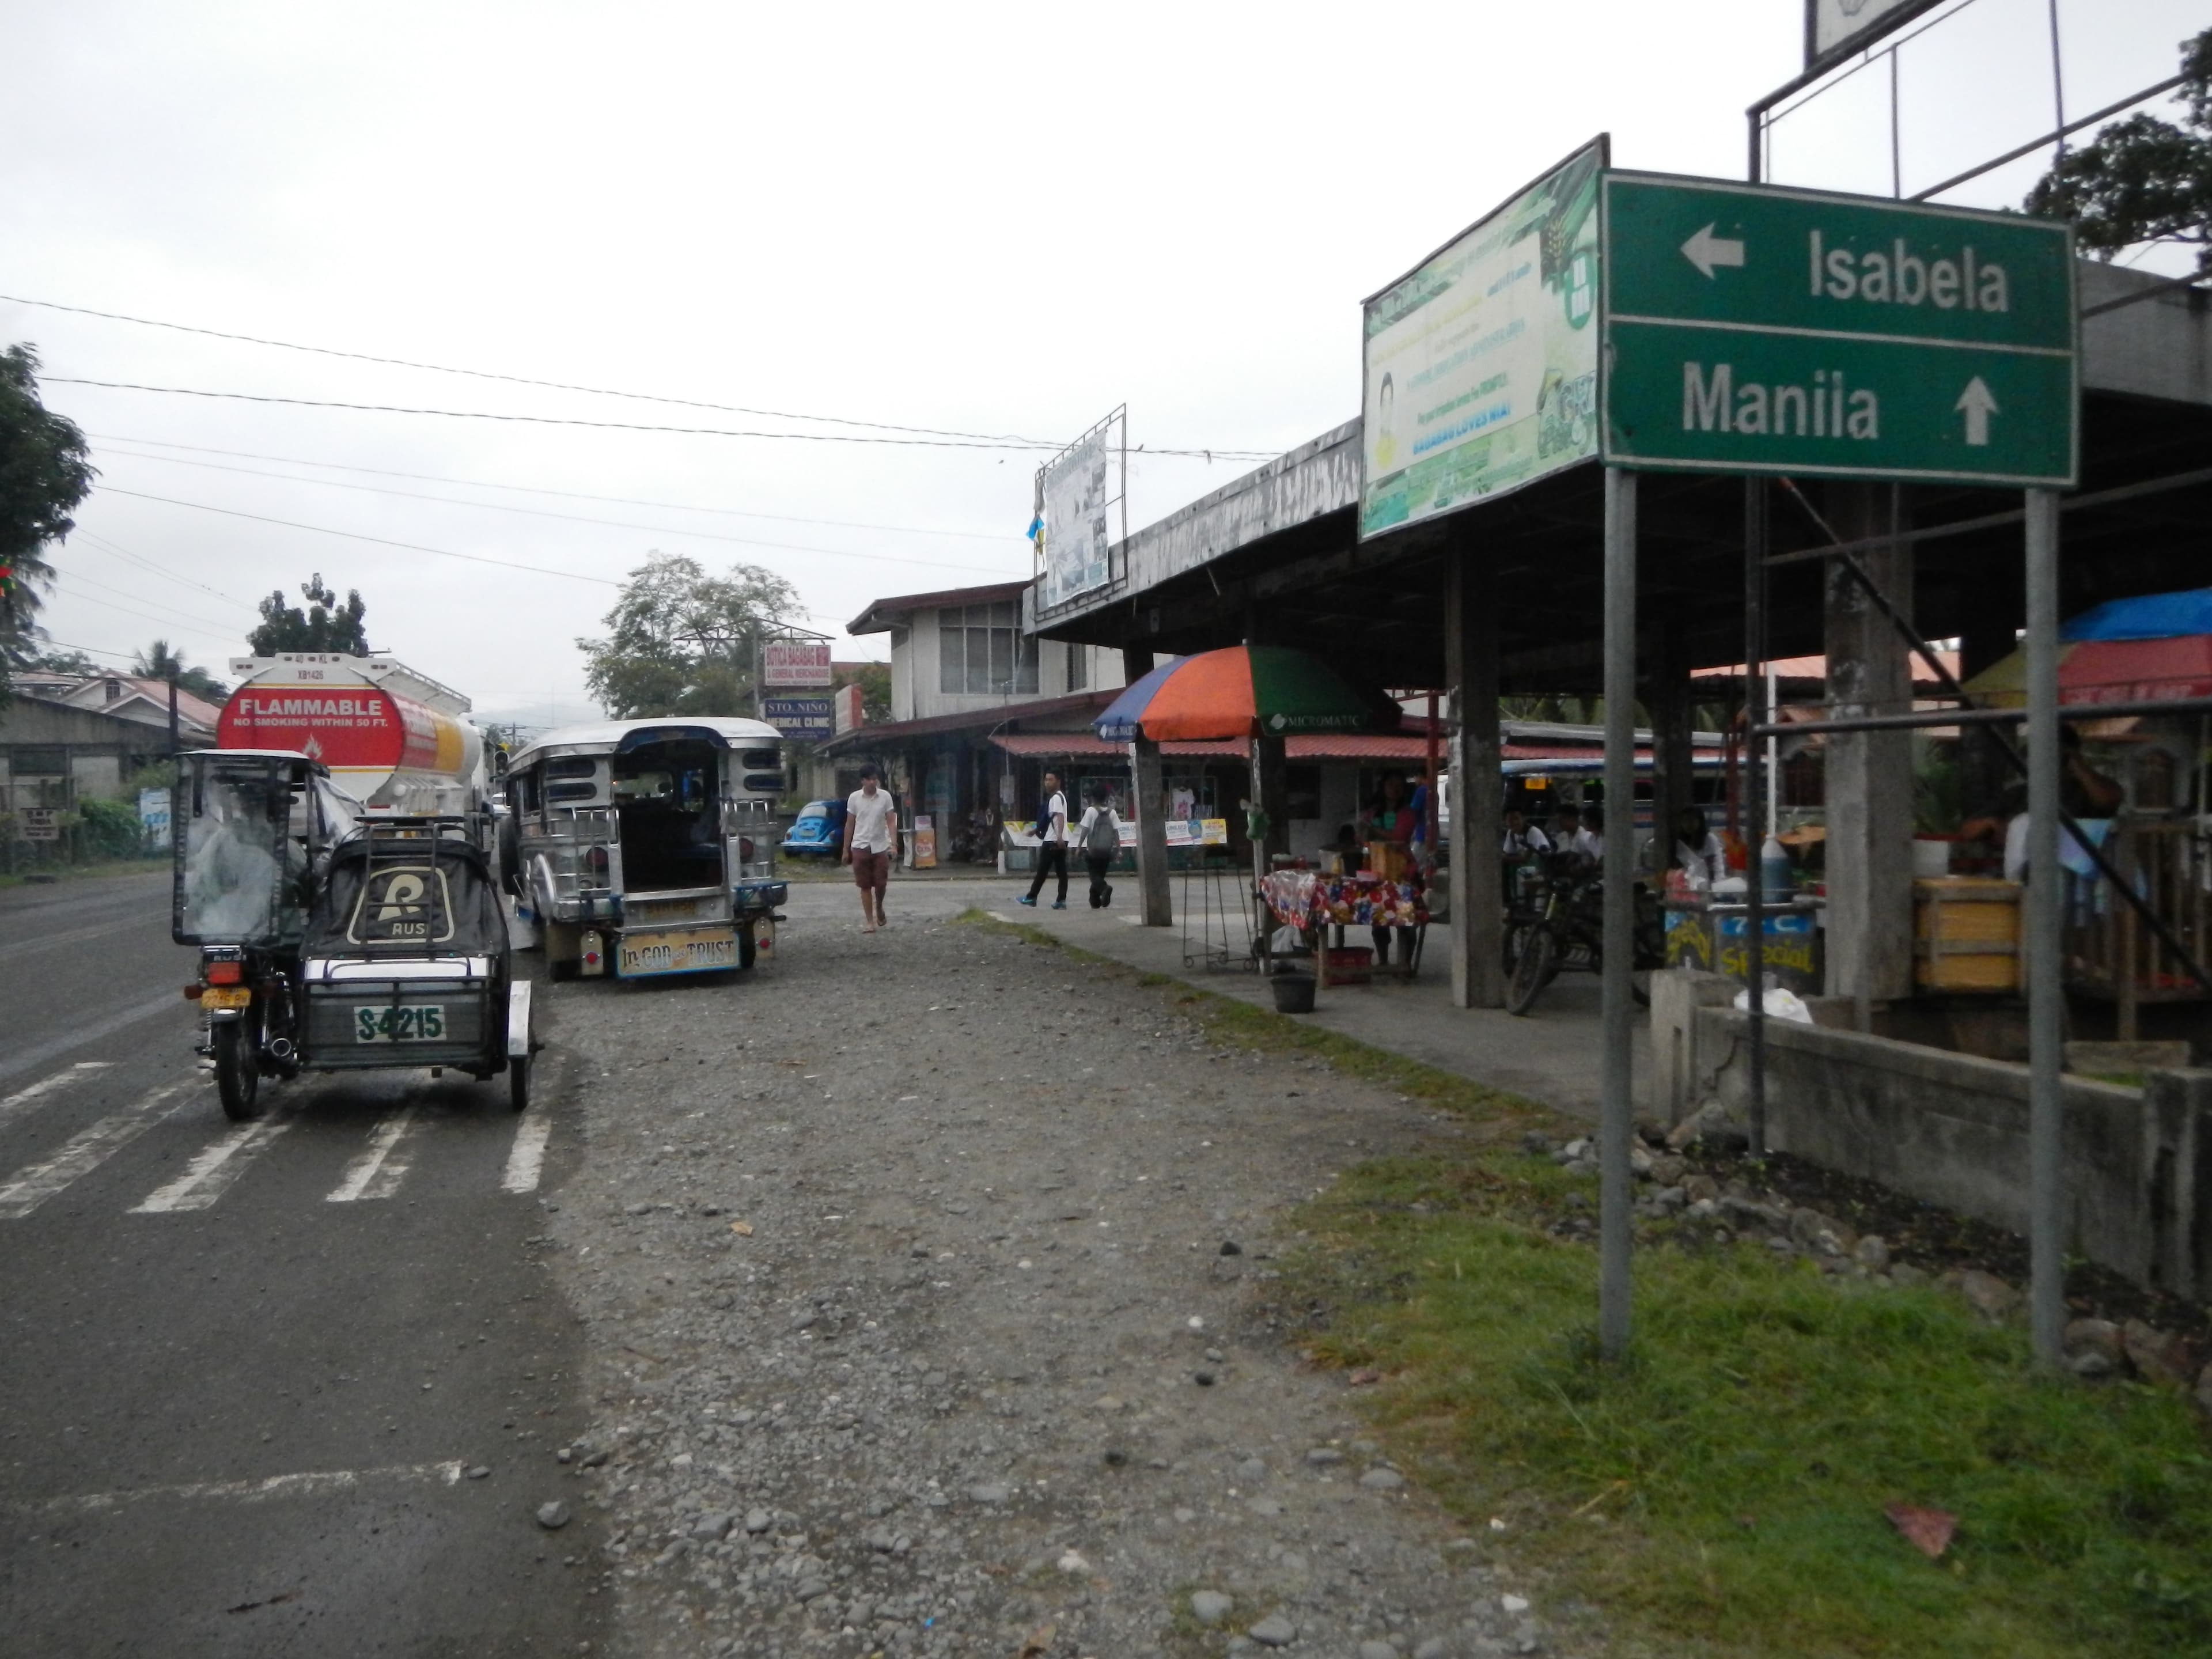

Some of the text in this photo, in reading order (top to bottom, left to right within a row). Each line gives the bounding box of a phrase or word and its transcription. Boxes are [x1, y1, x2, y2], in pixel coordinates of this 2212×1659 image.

[1809, 229, 2010, 313] Isabela
[1682, 361, 1879, 440] Manila
[295, 654, 328, 664] 40 KL
[239, 699, 382, 716] FLAMMABLE
[768, 700, 828, 713] STO. NIÑO
[233, 718, 388, 727] NO SMOKING WITHIN 50 FT.
[767, 717, 830, 728] MEDICAL CLINIC
[1288, 714, 1360, 726] MICROMATIC
[392, 922, 429, 935] RUS
[641, 944, 673, 969] GOD
[686, 940, 734, 965] TRUST
